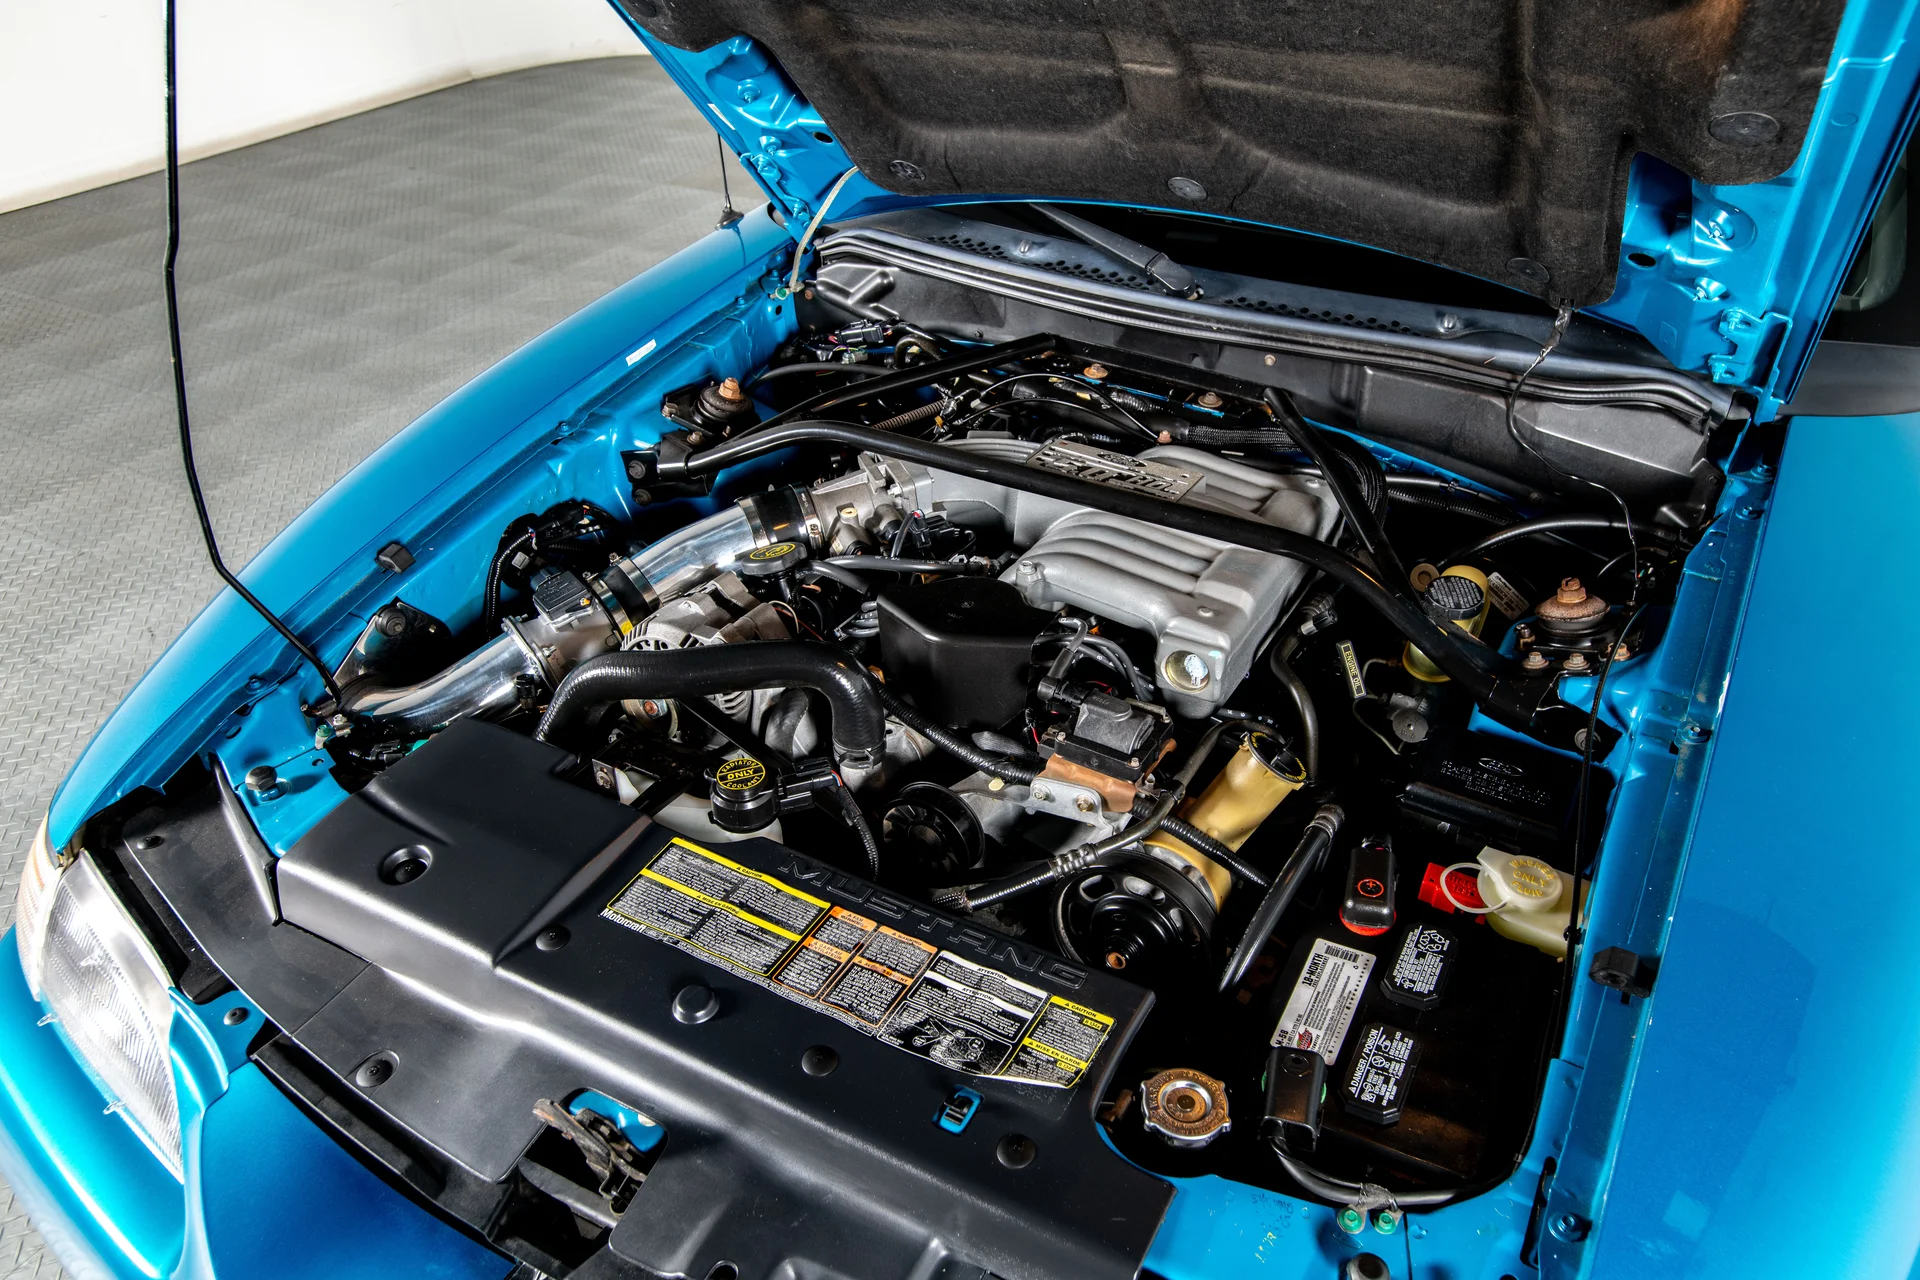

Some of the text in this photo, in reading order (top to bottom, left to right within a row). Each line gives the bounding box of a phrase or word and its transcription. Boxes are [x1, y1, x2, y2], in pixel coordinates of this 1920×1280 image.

[1344, 651, 1361, 690] ENGINE OIL
[721, 760, 757, 772] RADIATOR
[727, 768, 754, 780] ONLY
[726, 776, 760, 788] COOLANT
[1509, 858, 1555, 880] WASHER
[1513, 869, 1548, 888] ONLY
[1512, 880, 1544, 897] FLUID
[600, 908, 647, 934] Motorcraft
[777, 861, 1089, 989] MUSTANG
[1302, 953, 1325, 987] 18-MONTH
[1071, 1005, 1097, 1018] CAUTION
[1035, 1043, 1050, 1053] MISE
[1060, 1054, 1082, 1067] GARDE
[1351, 1058, 1368, 1086] DANGER
[1363, 1028, 1379, 1053] POISON
